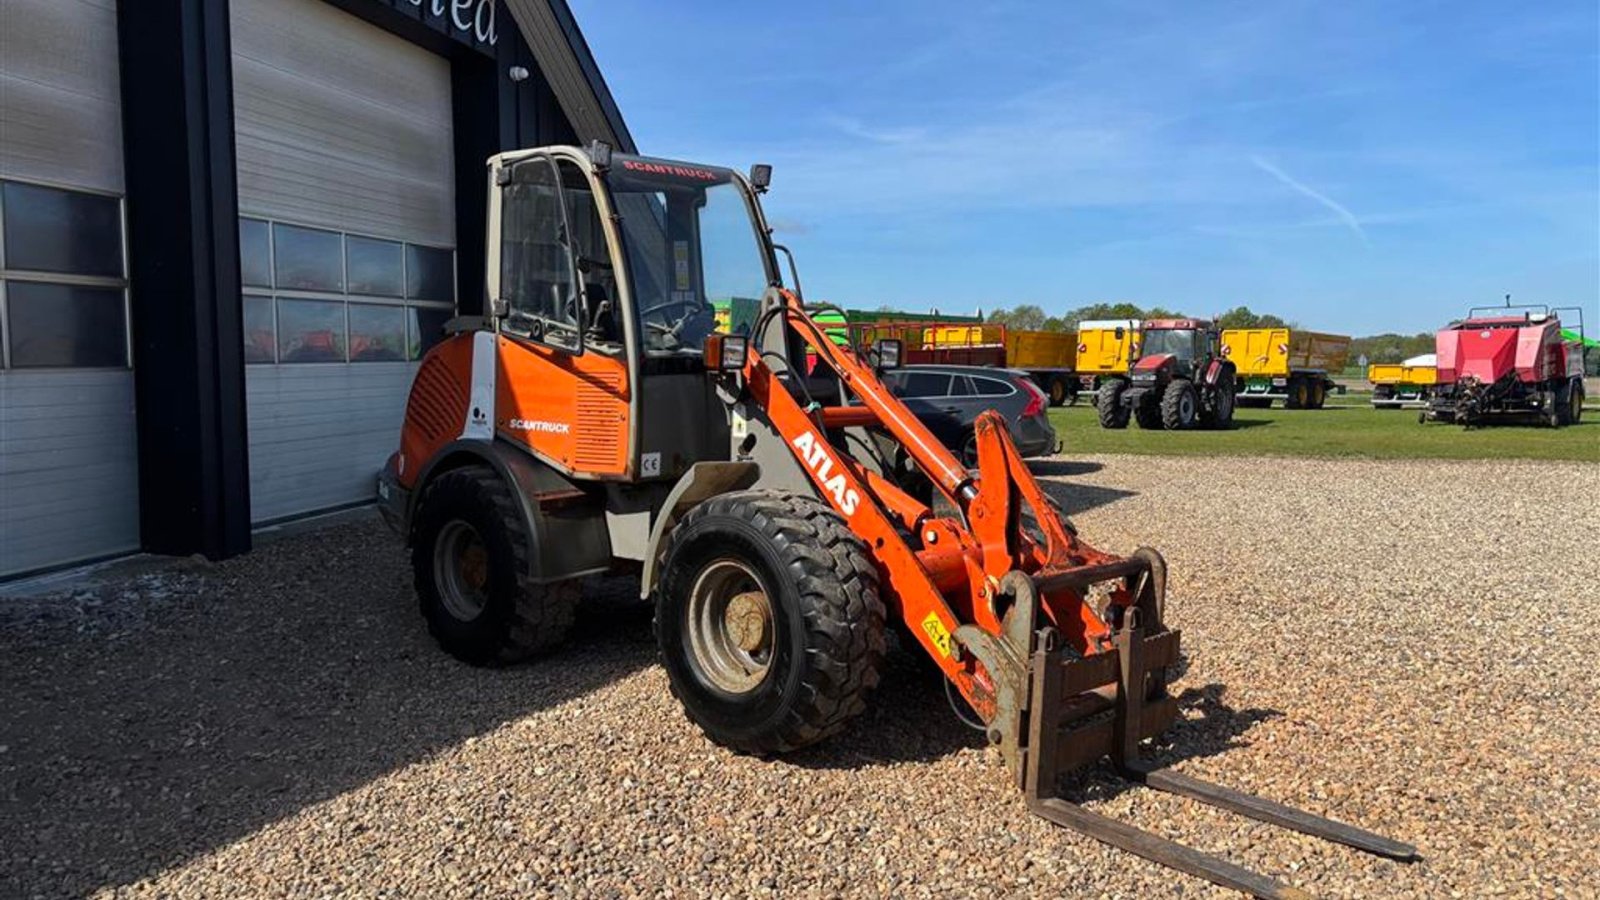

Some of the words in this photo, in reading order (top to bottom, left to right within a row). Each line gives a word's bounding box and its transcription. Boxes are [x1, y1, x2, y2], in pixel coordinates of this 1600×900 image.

[622, 160, 717, 181] SCANTRUCK
[509, 418, 570, 434] SCANTRUCK
[793, 431, 860, 516] ATLAS
